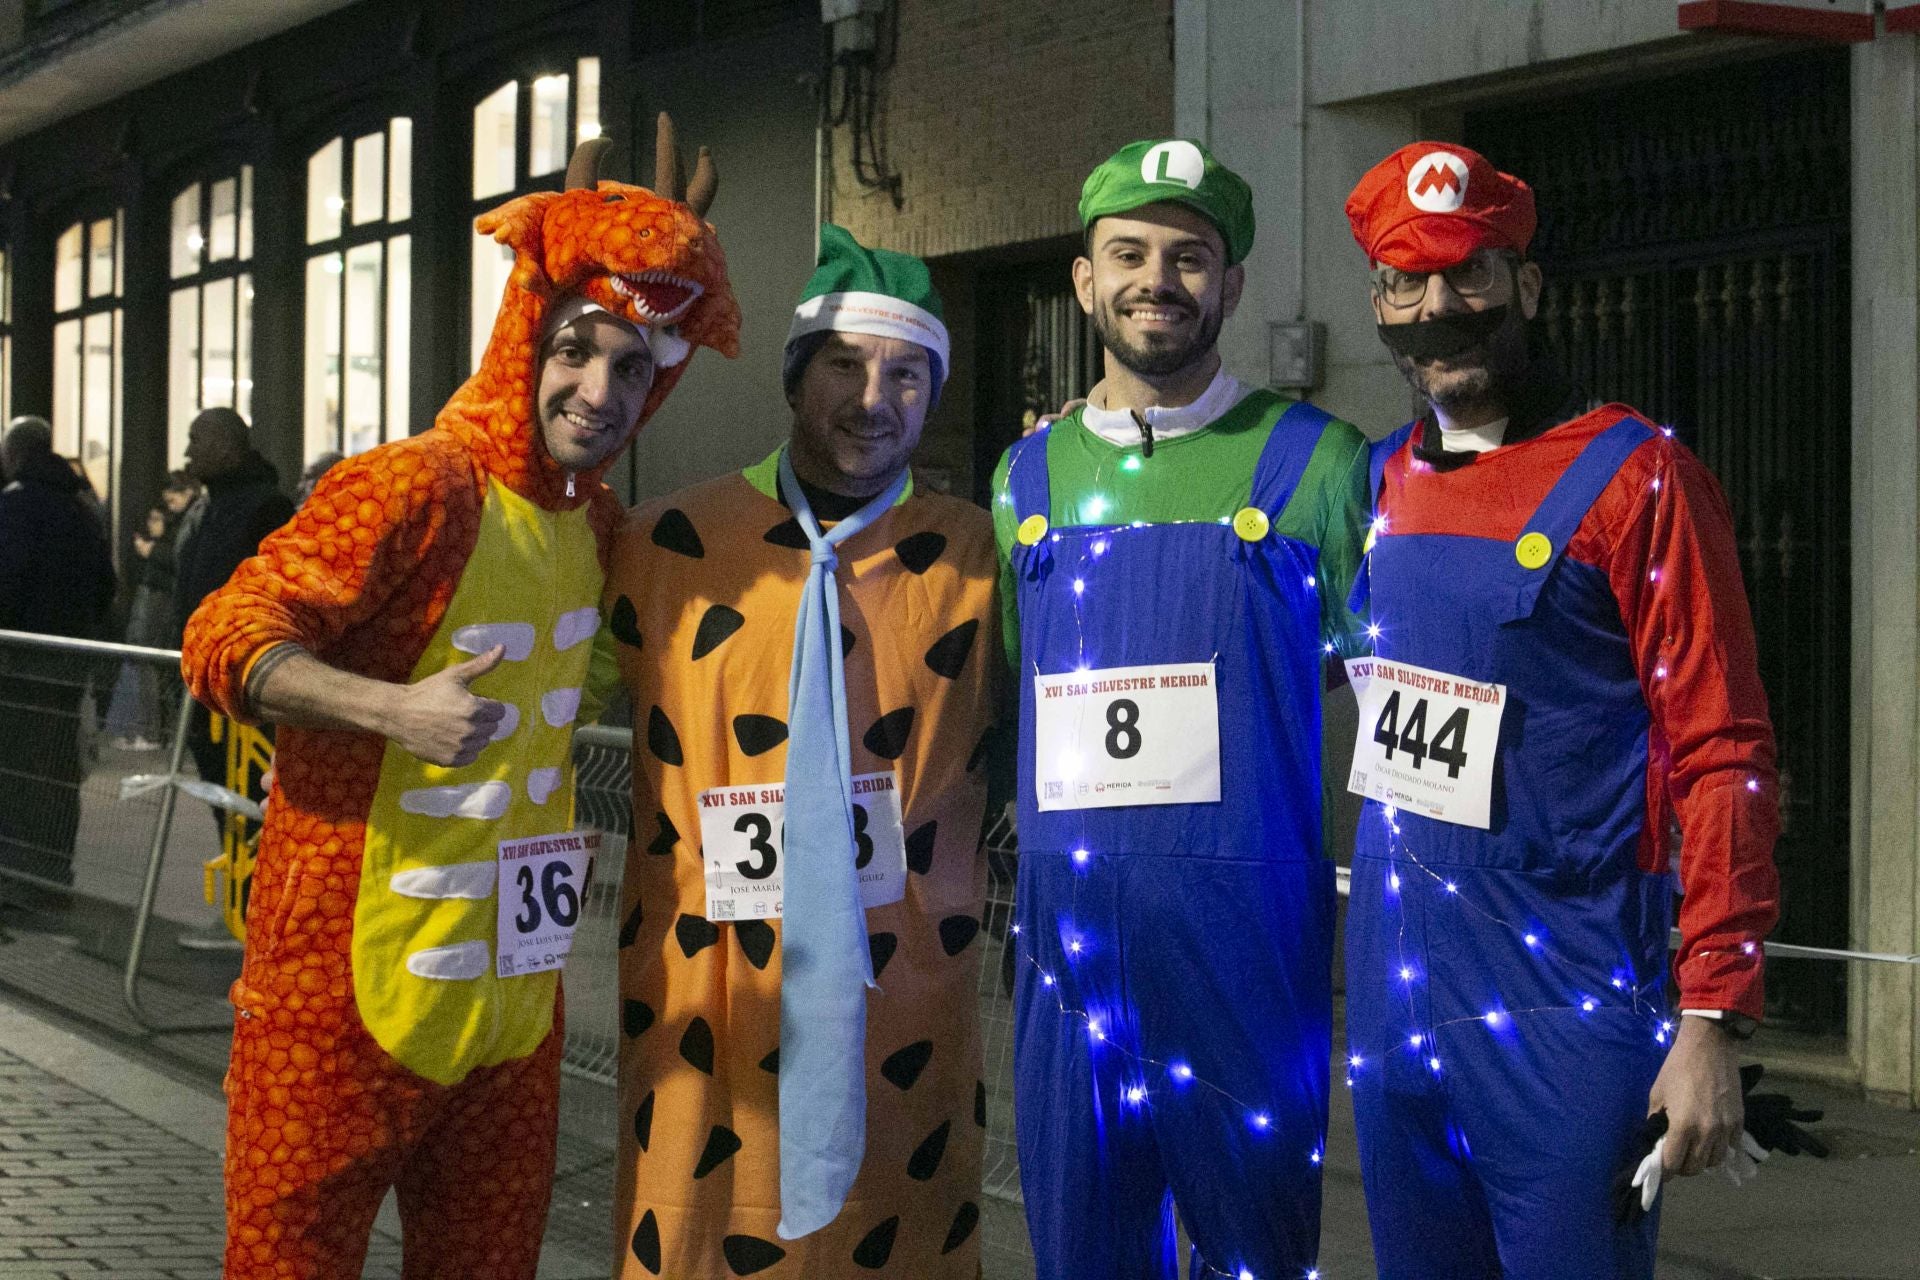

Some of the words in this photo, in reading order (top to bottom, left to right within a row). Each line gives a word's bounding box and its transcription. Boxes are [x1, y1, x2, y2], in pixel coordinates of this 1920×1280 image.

[1155, 151, 1188, 185] L
[1414, 162, 1461, 197] M
[846, 305, 890, 317] SILVESTRE
[1045, 686, 1063, 698] XVI
[1067, 683, 1088, 697] SAN
[1091, 677, 1156, 694] SILVESTRE
[1160, 674, 1208, 689] MERIDA
[1352, 663, 1374, 678] XVI
[1377, 665, 1395, 681] SAN
[1397, 669, 1450, 695] SILVESTRE
[1454, 683, 1500, 705] MERIDA
[1105, 698, 1142, 760] 8
[1374, 690, 1470, 779] 444
[702, 793, 725, 808] XVI
[730, 791, 756, 806] SAN
[852, 776, 894, 795] ERIDA
[1423, 779, 1455, 794] MOLANO
[502, 845, 516, 860] XVI
[517, 844, 529, 859] SAN
[529, 837, 582, 857] SILVESTRE
